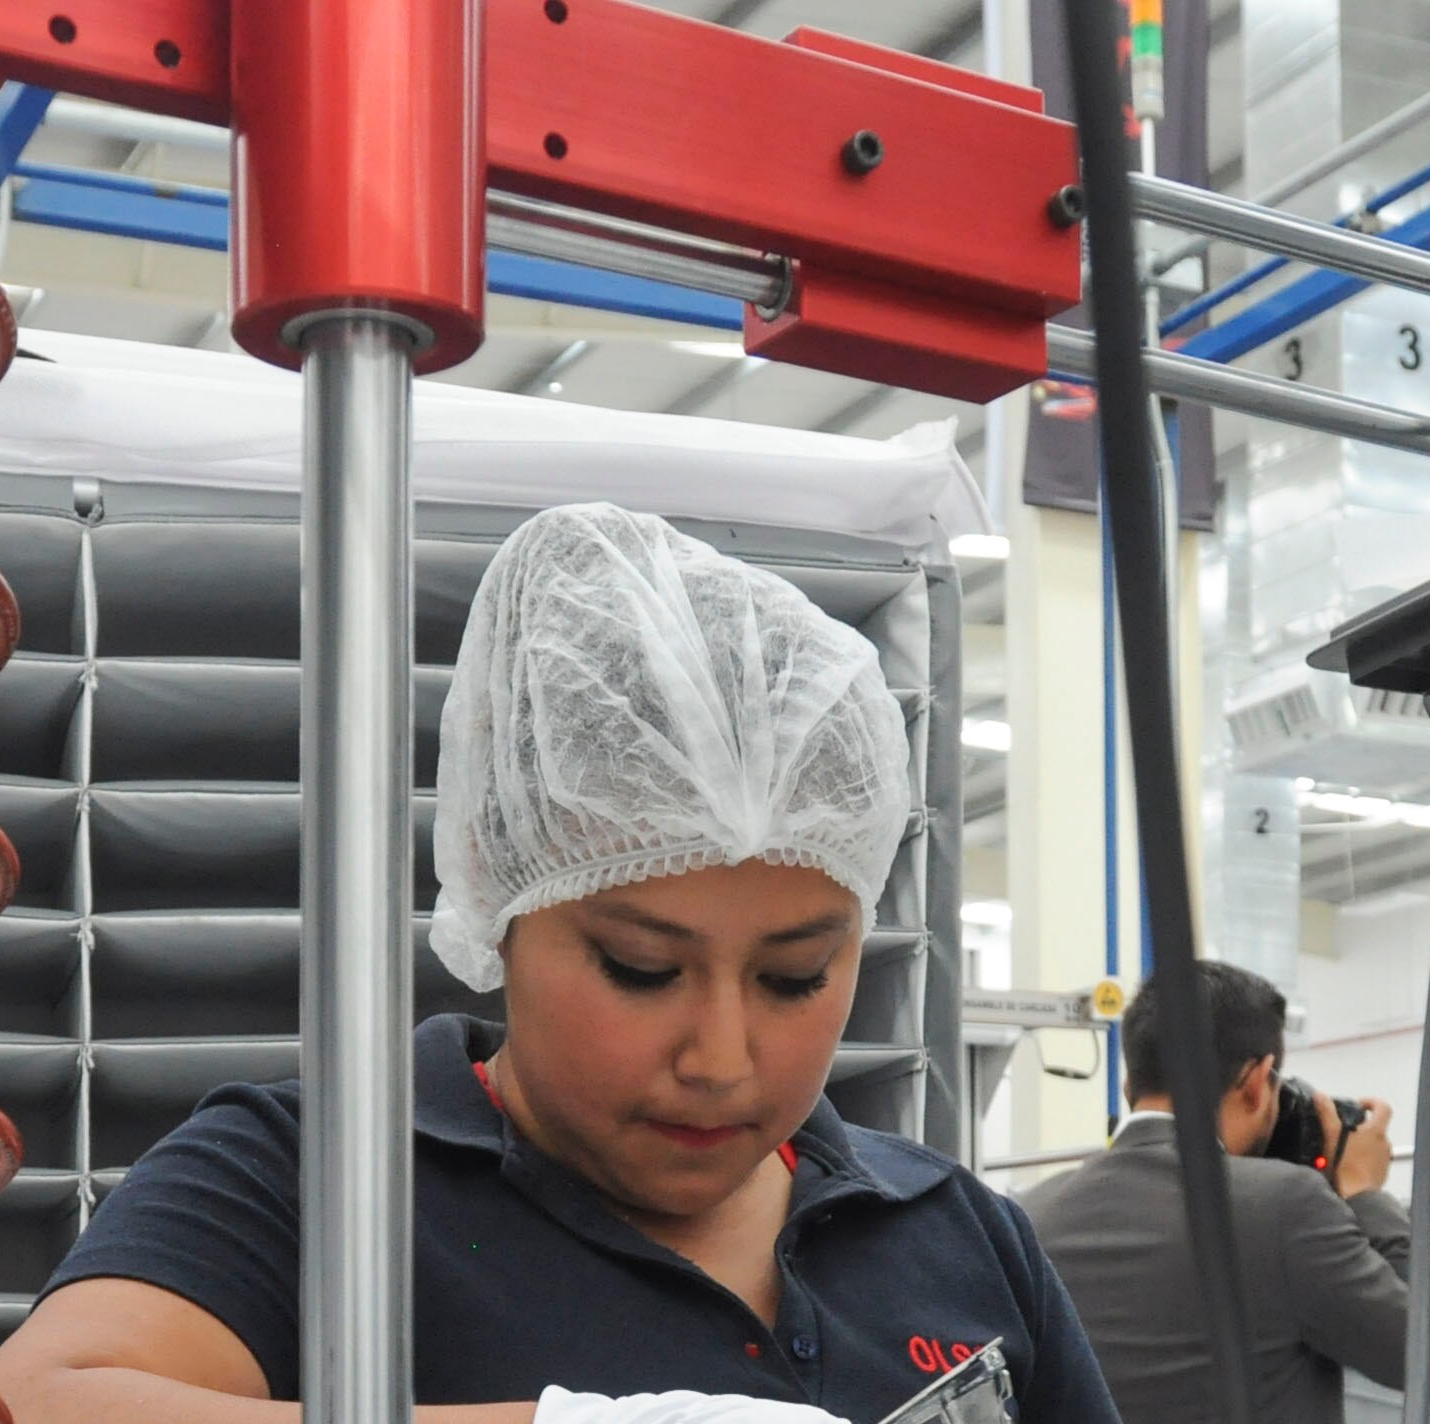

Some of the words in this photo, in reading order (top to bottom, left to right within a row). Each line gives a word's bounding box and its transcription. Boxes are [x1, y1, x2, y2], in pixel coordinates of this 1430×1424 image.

[1284, 337, 1303, 381] 3
[1398, 326, 1421, 371] 3
[1254, 807, 1269, 834] 2
